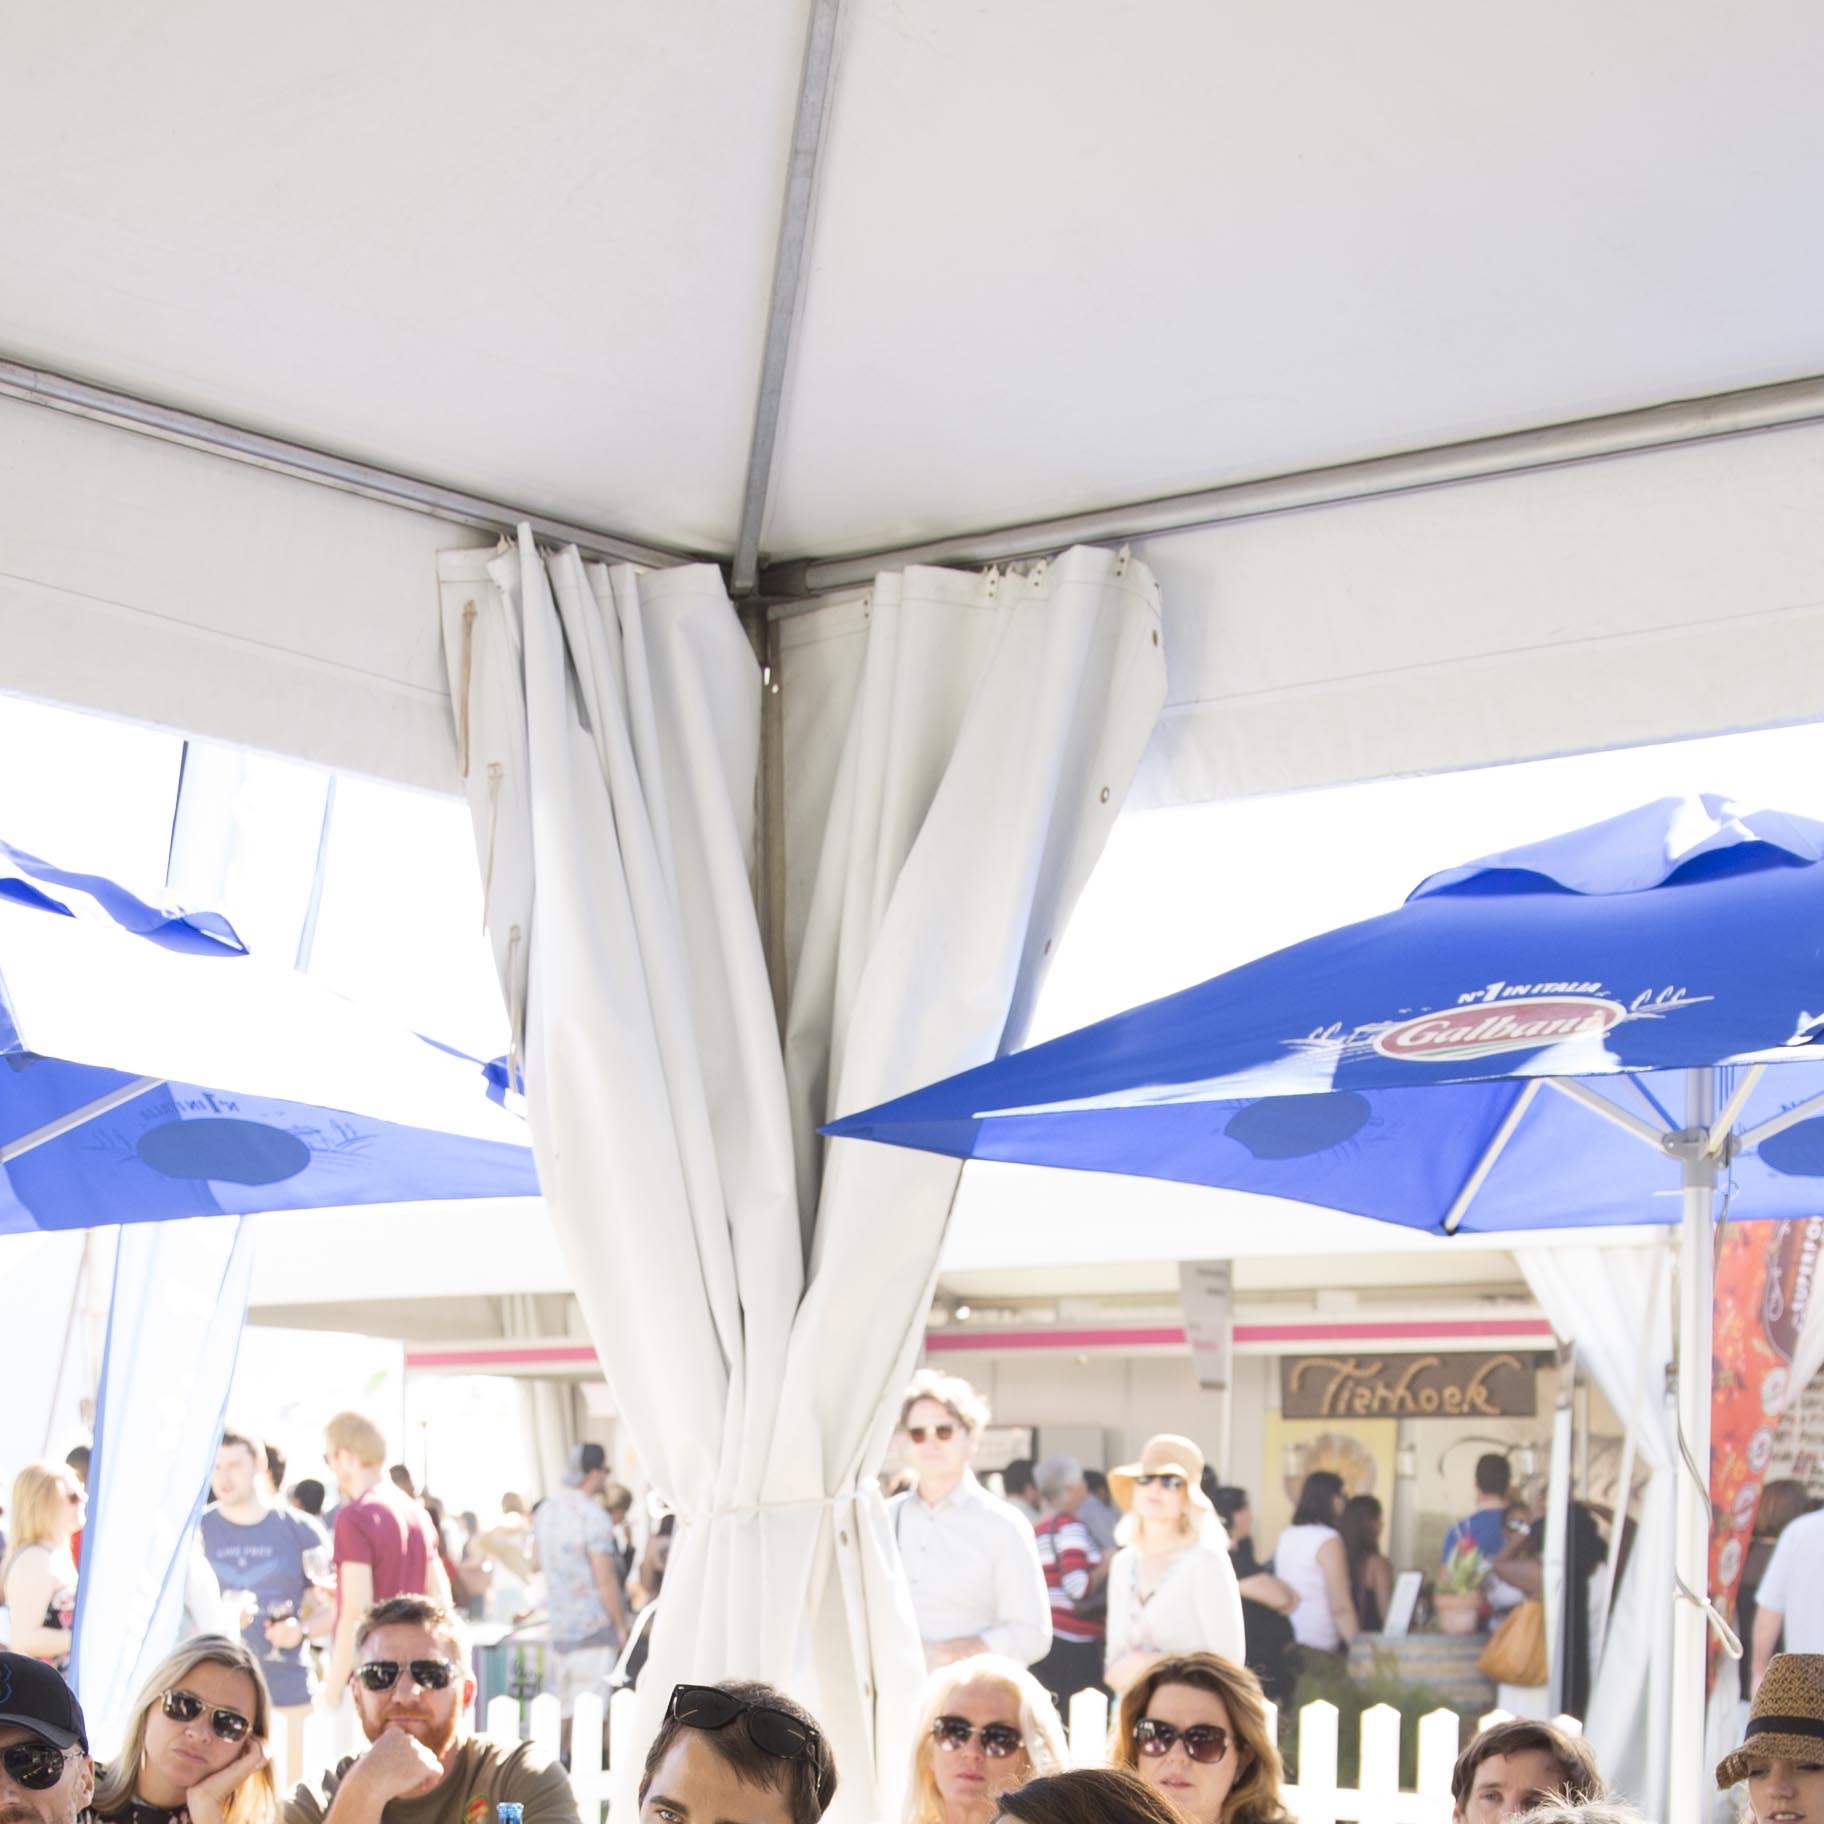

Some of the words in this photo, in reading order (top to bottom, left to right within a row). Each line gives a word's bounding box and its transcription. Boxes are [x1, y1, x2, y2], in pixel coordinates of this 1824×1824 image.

[1530, 981, 1603, 995] ITALIA
[1396, 1009, 1609, 1047] Galbani
[1290, 1354, 1522, 1416] Tierhoek
